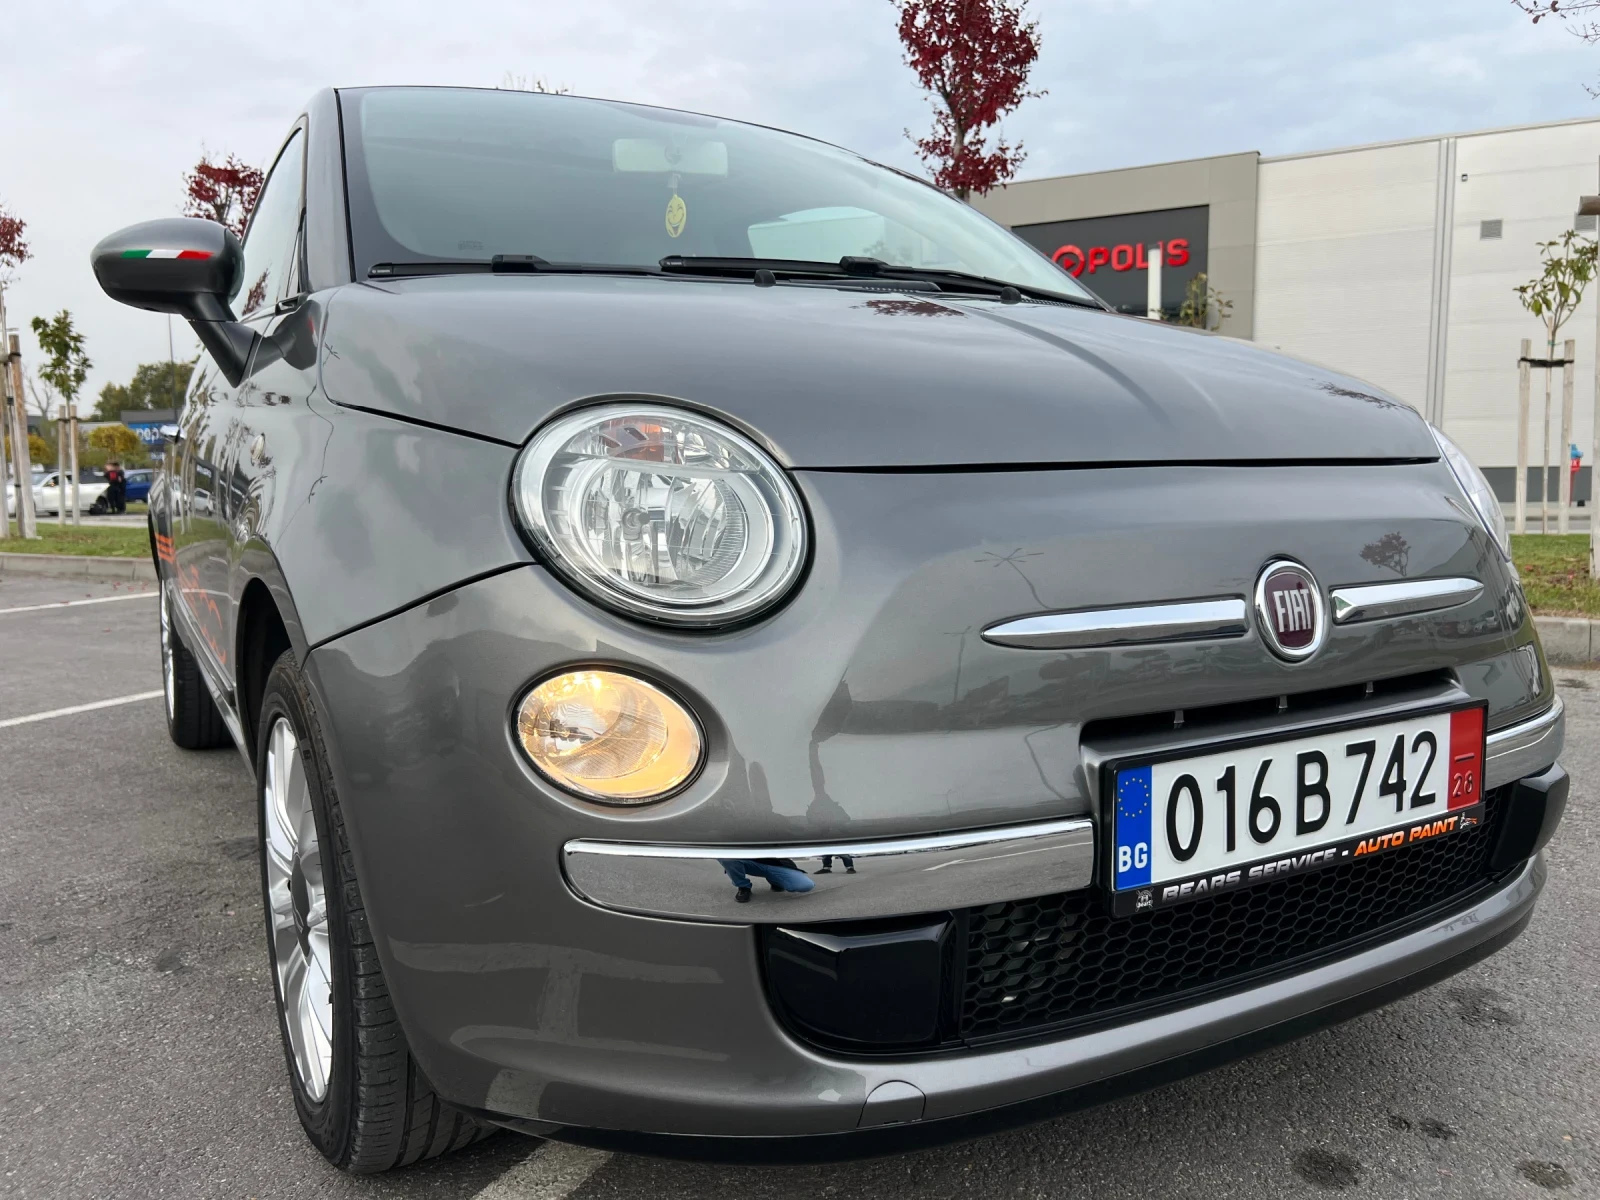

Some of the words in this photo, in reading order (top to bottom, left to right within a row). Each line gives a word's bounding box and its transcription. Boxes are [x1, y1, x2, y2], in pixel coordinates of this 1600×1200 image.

[1273, 588, 1312, 633] FIAT
[1452, 770, 1474, 797] 28
[1118, 842, 1148, 873] BG
[1162, 871, 1242, 903] BEARS
[1248, 847, 1337, 880] SERVICE
[1354, 831, 1405, 857] AUTO
[1409, 815, 1459, 842] PAINT
